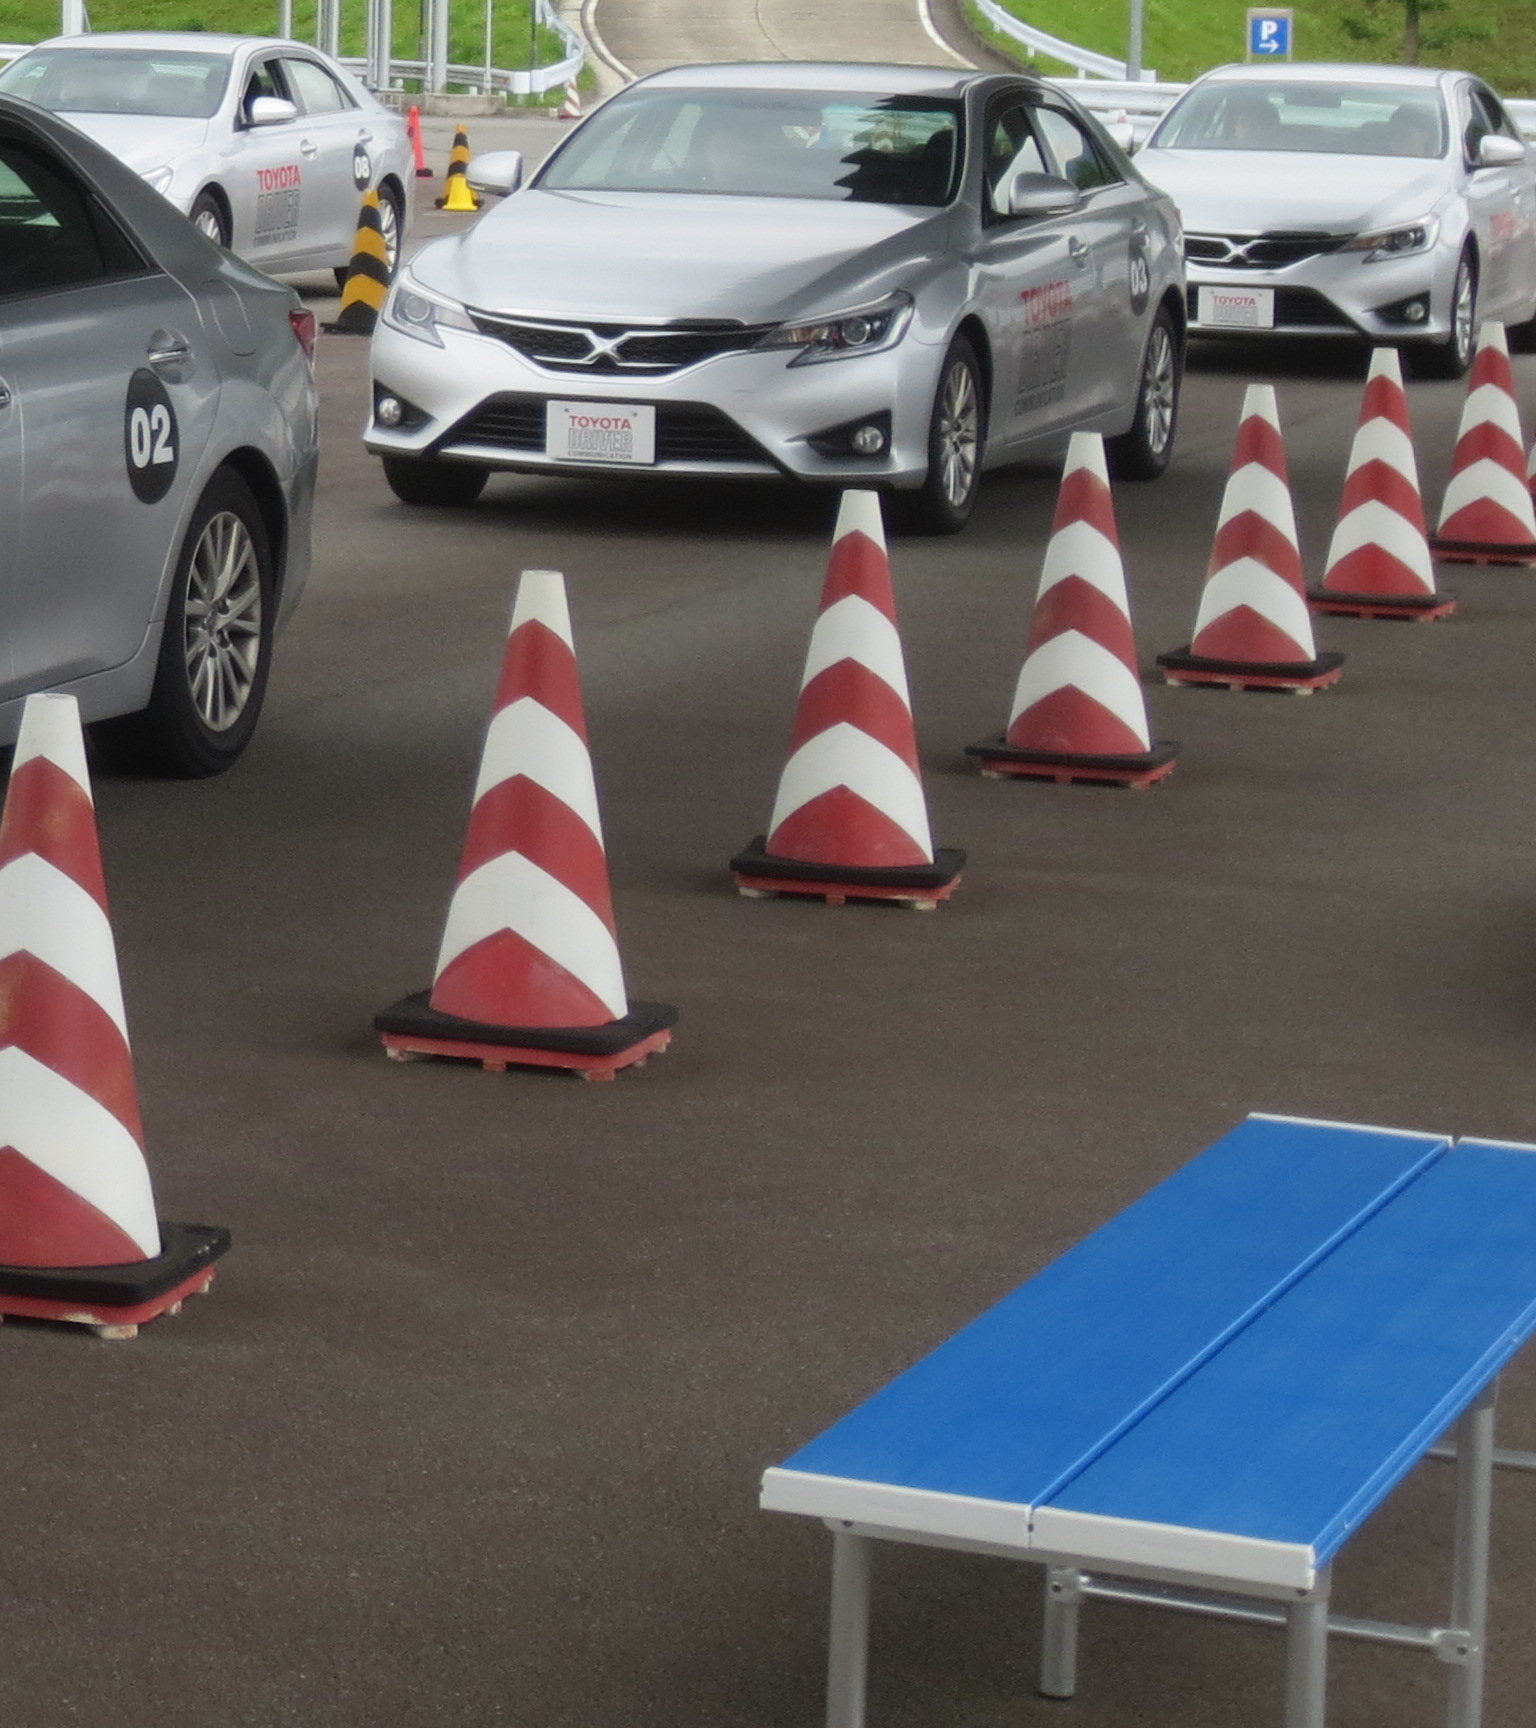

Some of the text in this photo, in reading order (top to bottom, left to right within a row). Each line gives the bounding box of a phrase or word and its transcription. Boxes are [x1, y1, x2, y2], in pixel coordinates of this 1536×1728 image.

[1261, 20, 1278, 41] P
[256, 165, 301, 190] TOYOTA
[354, 155, 369, 179] 08
[1131, 257, 1148, 297] 03
[1020, 280, 1073, 325] TOYOTA
[1213, 295, 1256, 307] TOYOTA
[569, 415, 632, 430] TOYOTA
[130, 403, 174, 469] 02
[568, 428, 633, 453] DRIVER
